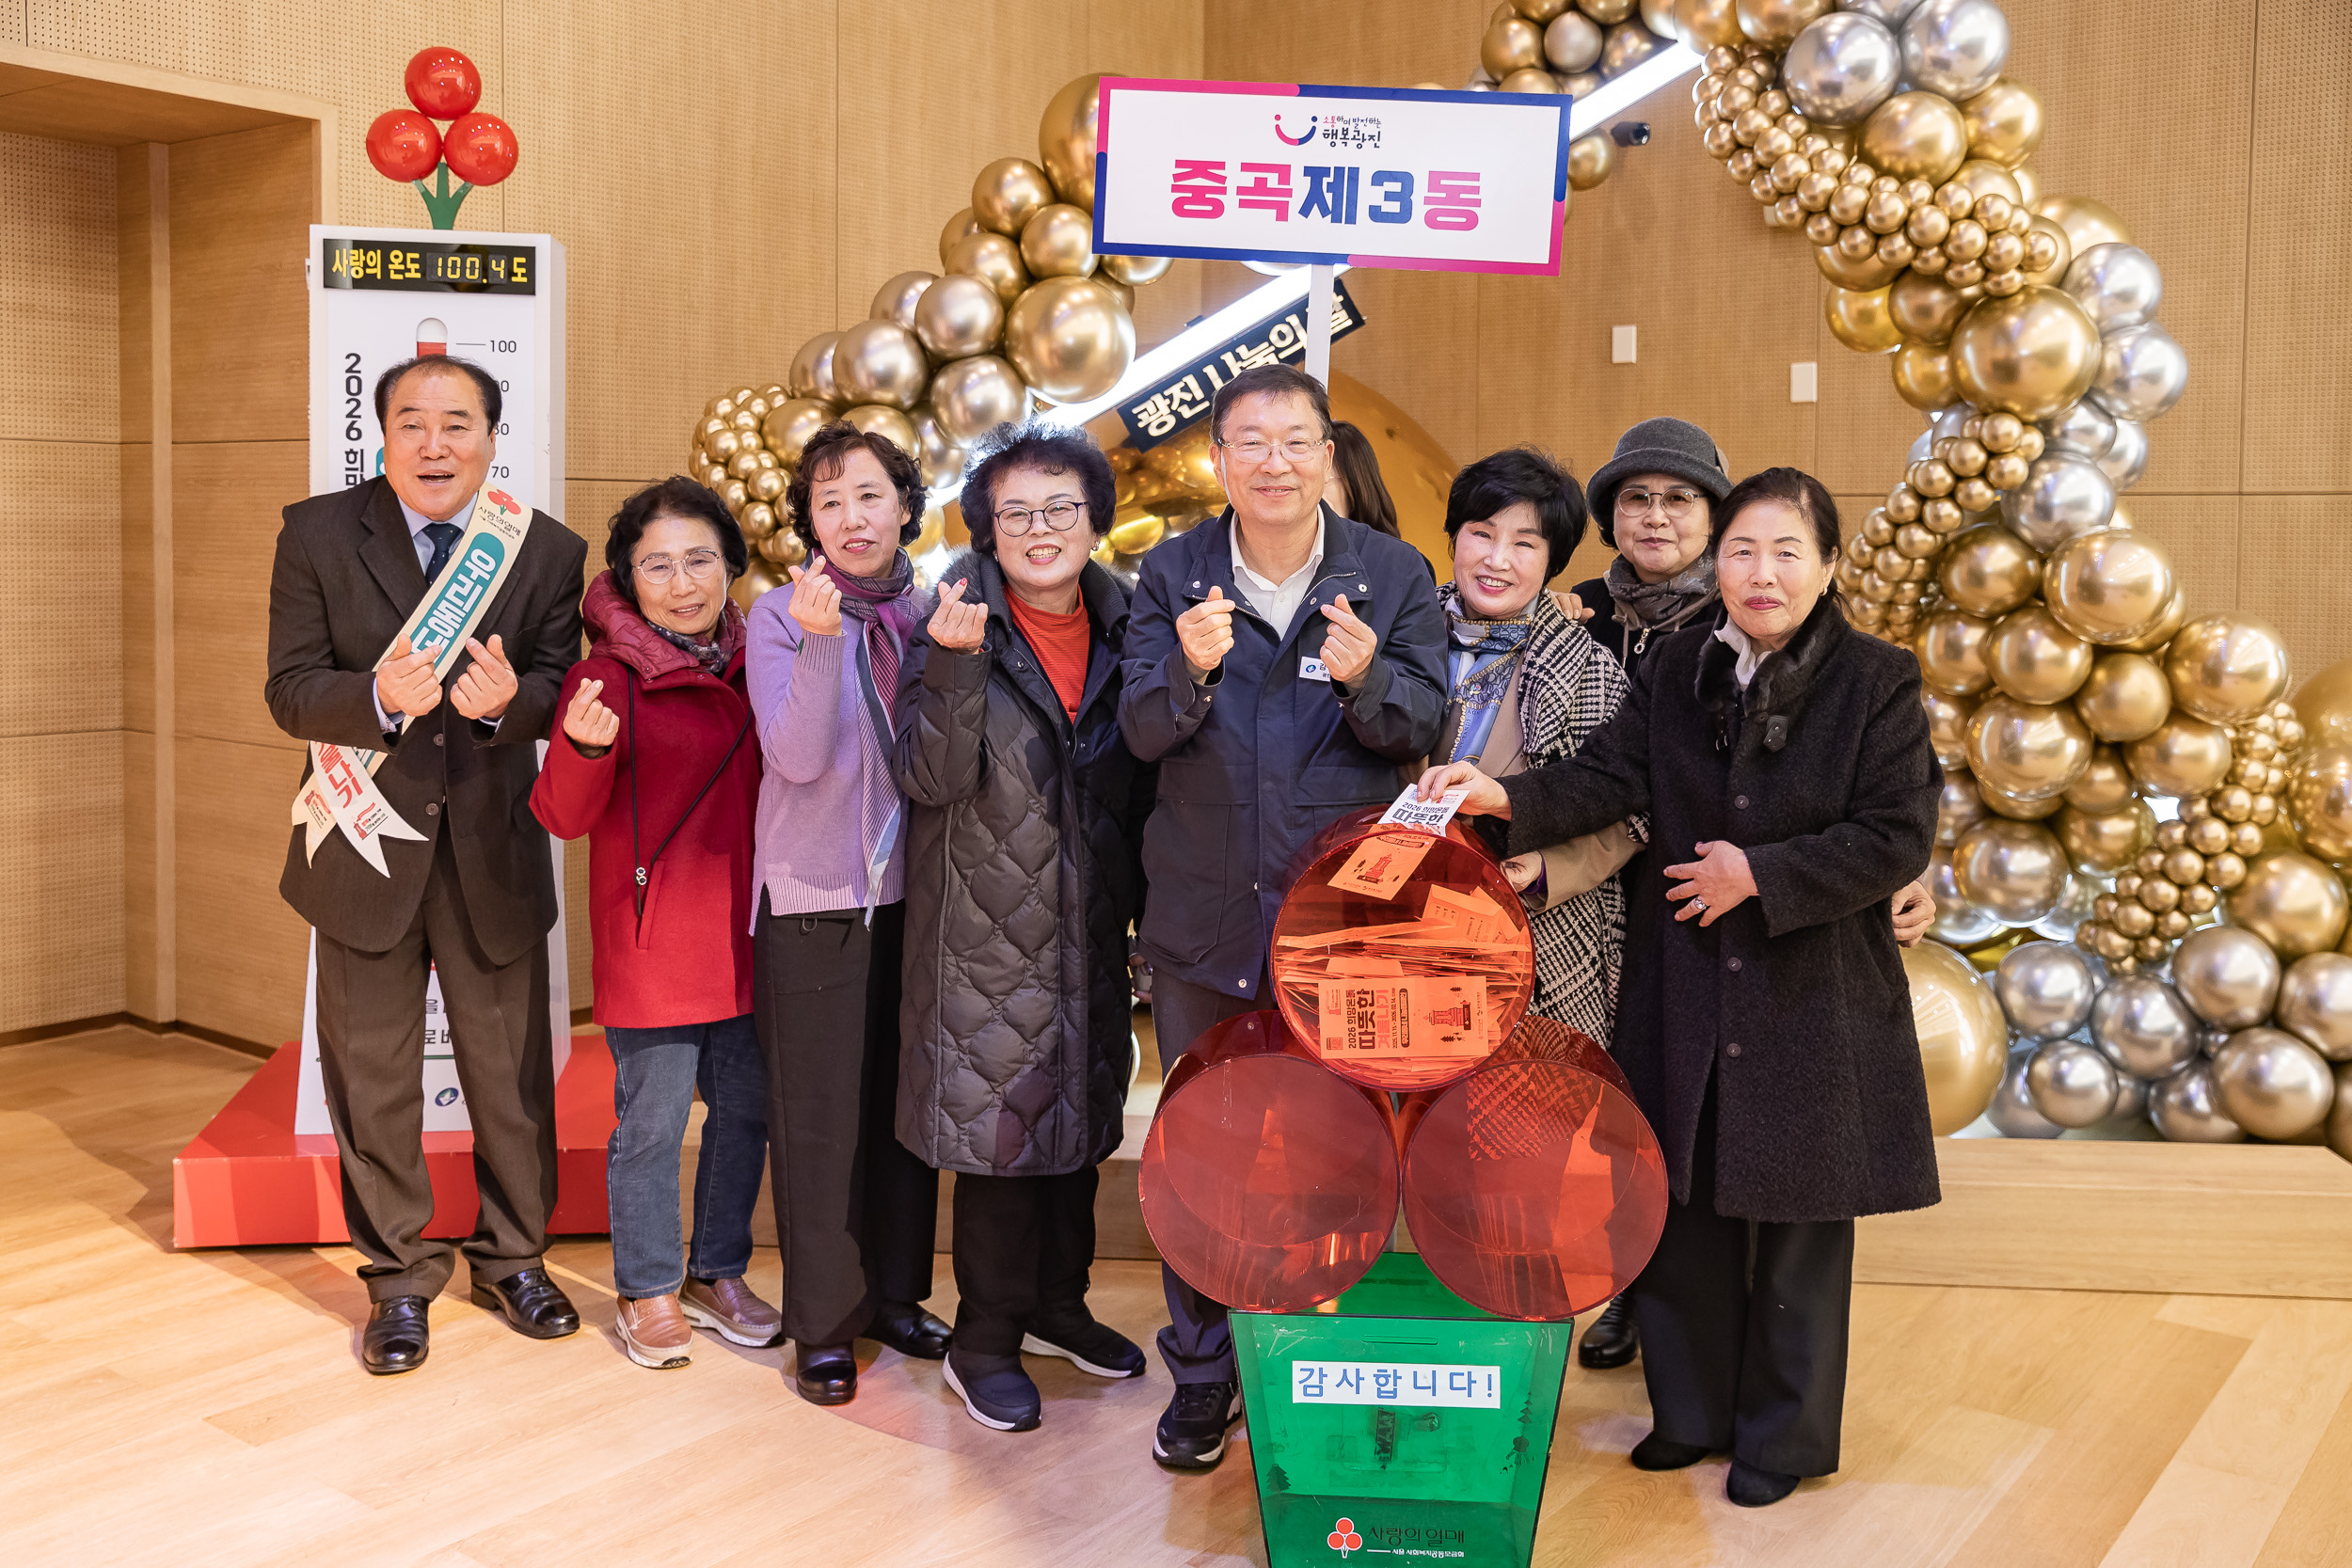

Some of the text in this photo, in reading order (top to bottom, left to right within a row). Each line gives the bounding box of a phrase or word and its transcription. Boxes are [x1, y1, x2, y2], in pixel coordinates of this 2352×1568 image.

[1322, 127, 1380, 150] 행복광진
[1171, 159, 1482, 231] 중곡제3동
[332, 248, 381, 279] 사랑의
[388, 249, 421, 280] 온도
[489, 340, 516, 353] 100
[1132, 373, 1211, 437] 광진
[491, 466, 510, 479] 70
[1357, 989, 1375, 1049] 따뜻한
[1375, 990, 1390, 1049] 겨울나기
[1347, 1026, 1357, 1049] 2026
[1297, 1367, 1493, 1399] 감사합니다!
